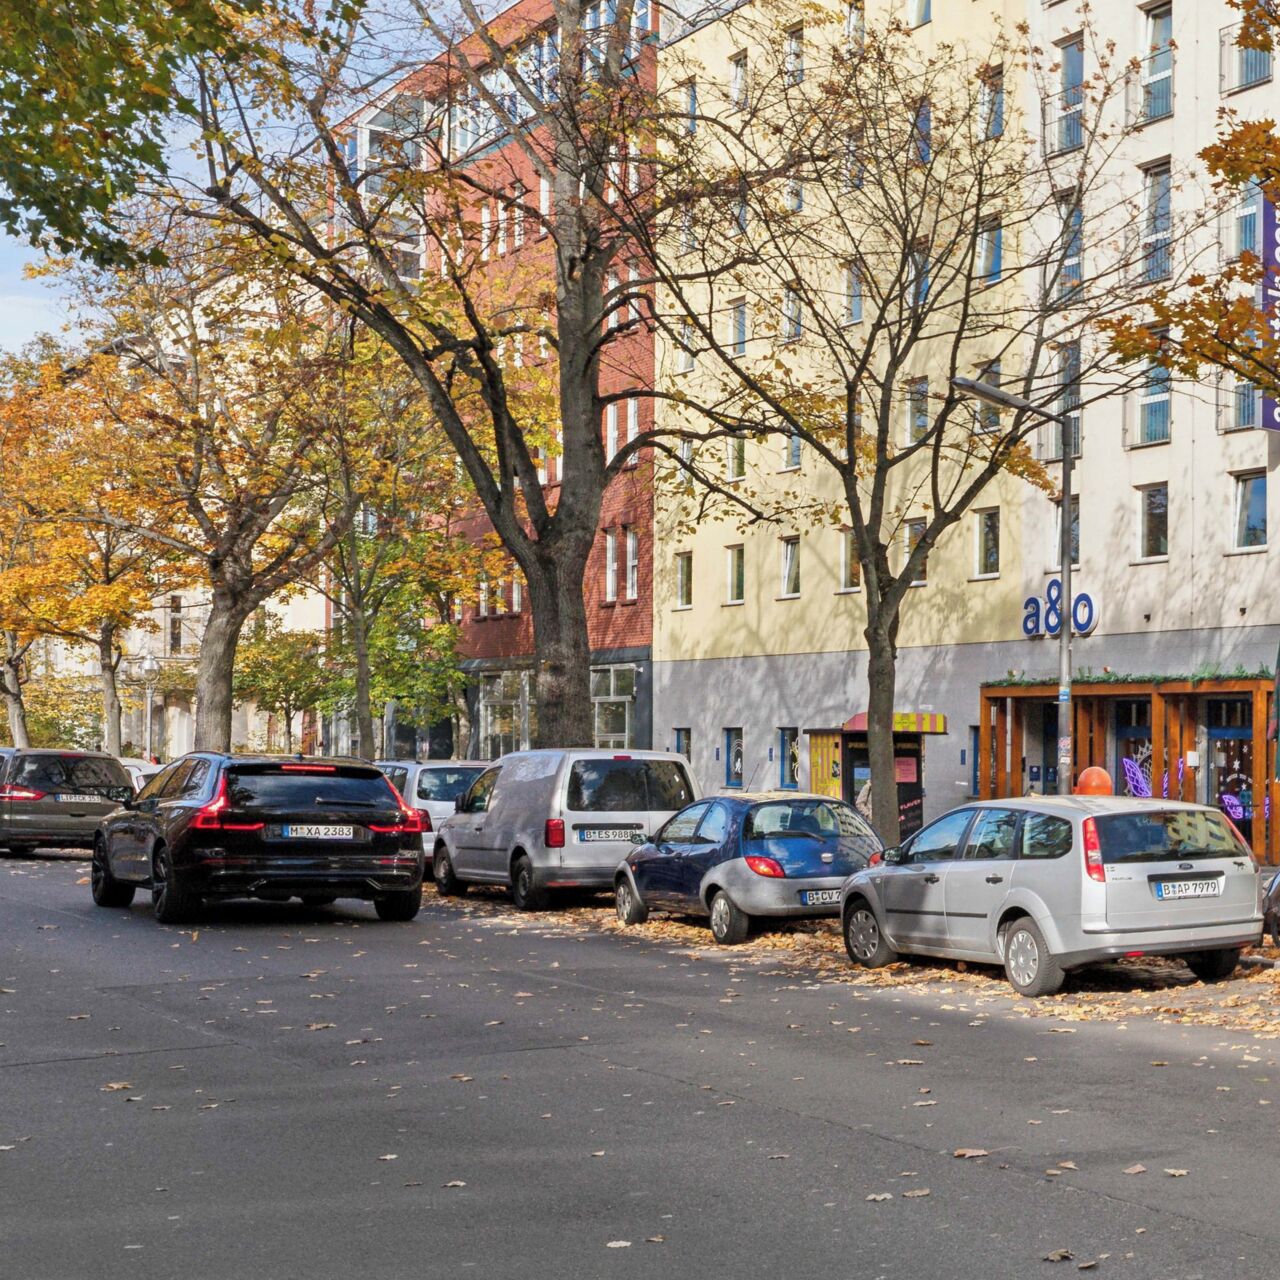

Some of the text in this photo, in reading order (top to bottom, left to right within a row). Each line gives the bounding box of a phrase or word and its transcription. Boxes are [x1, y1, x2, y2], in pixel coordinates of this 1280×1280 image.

[290, 827, 352, 836] M XA 2383
[585, 831, 593, 839] B
[1163, 881, 1217, 896] B AP 7979
[808, 892, 815, 902] B
[821, 891, 834, 901] CV
